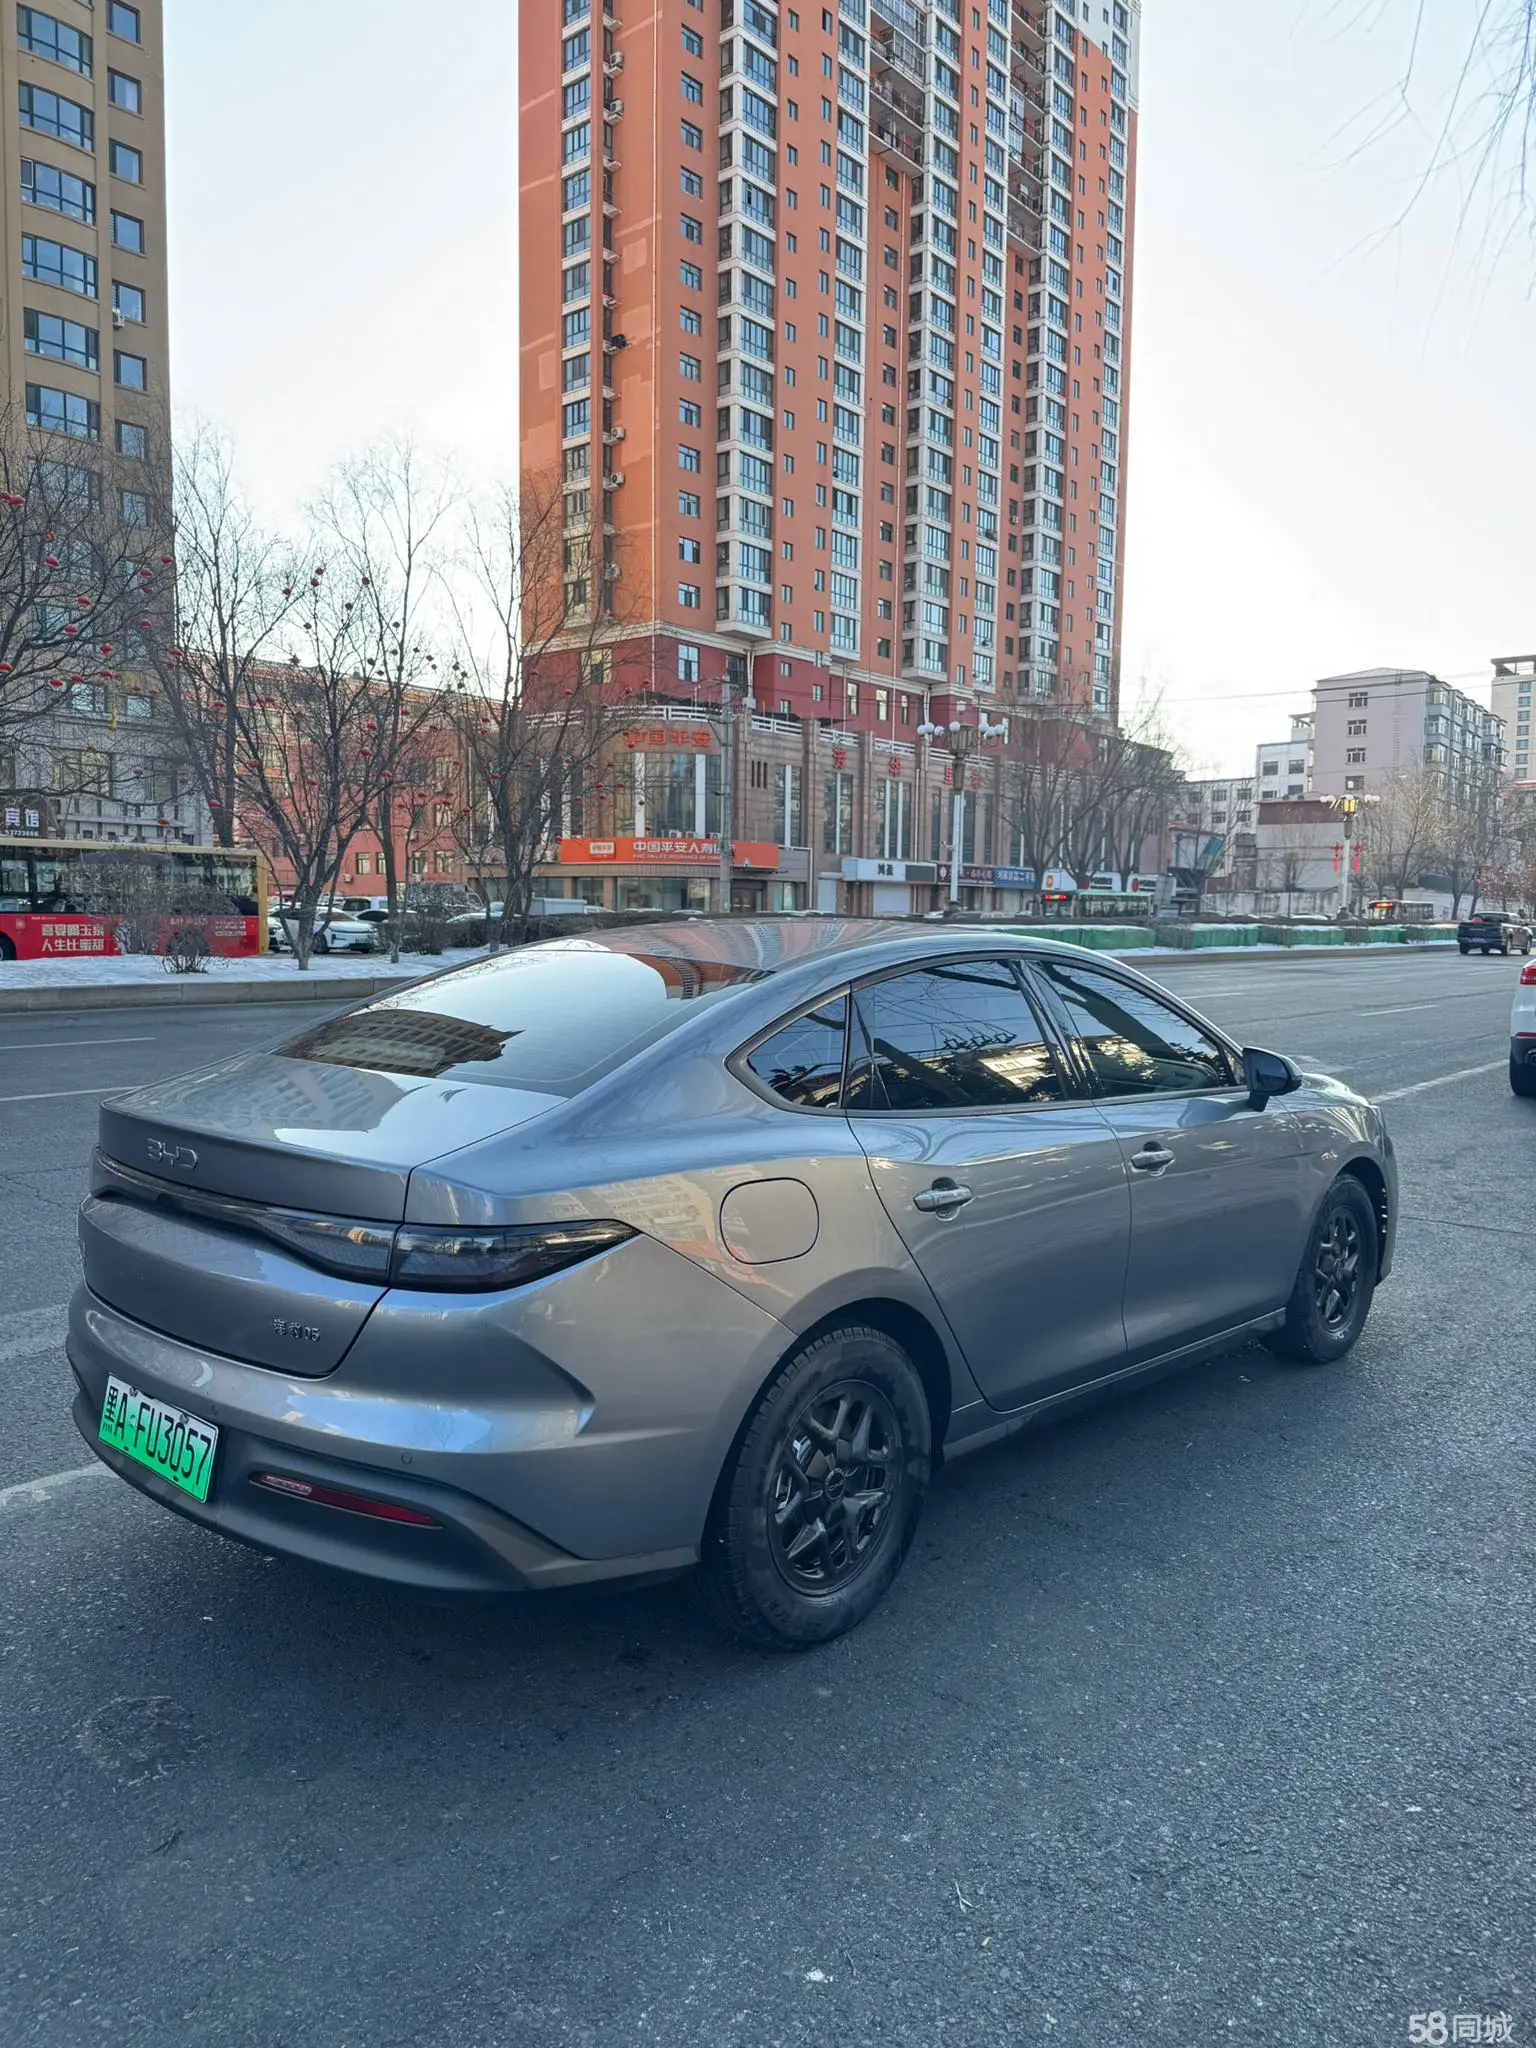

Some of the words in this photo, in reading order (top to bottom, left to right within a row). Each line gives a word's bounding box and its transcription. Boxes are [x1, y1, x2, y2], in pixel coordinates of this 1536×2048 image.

[622, 728, 712, 748] 中国平安
[4, 807, 40, 828] 宾馆
[41, 938, 105, 952] 人生比蜜甜
[145, 1137, 199, 1170] BYD
